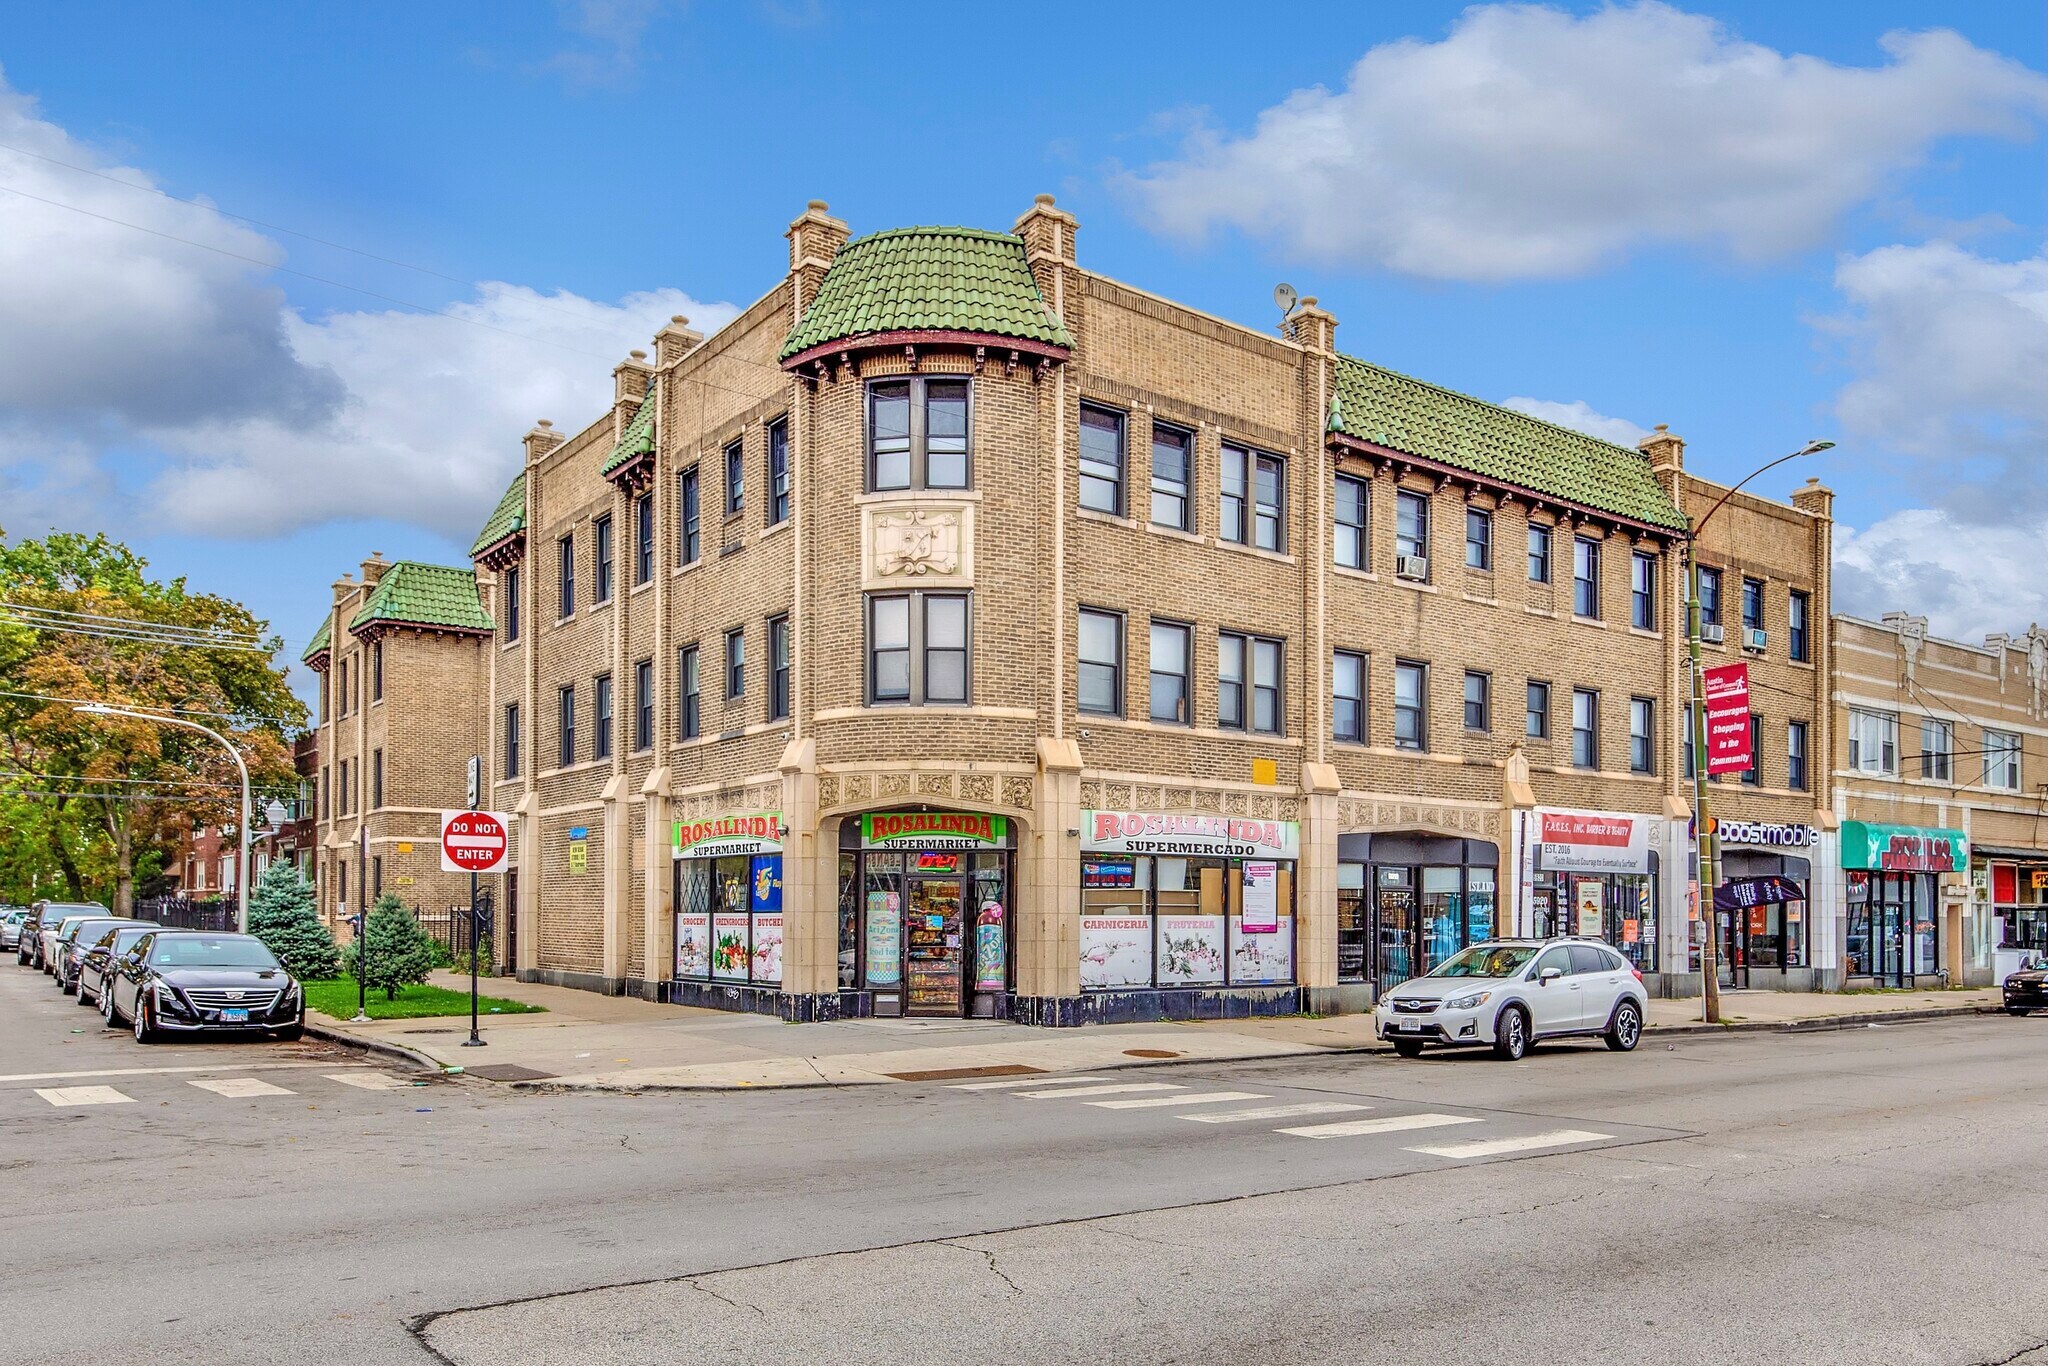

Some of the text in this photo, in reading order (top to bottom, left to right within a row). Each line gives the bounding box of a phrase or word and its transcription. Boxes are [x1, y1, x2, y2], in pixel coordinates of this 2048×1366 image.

[1709, 706, 1748, 719] Encourages
[1713, 722, 1745, 735] Shopping
[1728, 739, 1739, 748] the
[1710, 754, 1750, 766] Community
[452, 823, 498, 834] DO NOT
[680, 816, 781, 849] ROSALINDA
[872, 815, 993, 840] ROSALINDA
[1094, 813, 1282, 849] ROSALINDA
[1586, 825, 1605, 835] BARBER
[1611, 826, 1629, 836] BEAUTY
[694, 843, 762, 856] SUPERMARKET
[884, 839, 981, 849] SUPERMARKET
[1126, 840, 1256, 856] SUPERMERCADO
[1545, 844, 1571, 855] EST. 2016
[457, 849, 493, 860] ENTER
[682, 917, 706, 926] GROCERY
[1083, 920, 1148, 930] CARNICERIA
[1167, 920, 1216, 929] FRUTERIA
